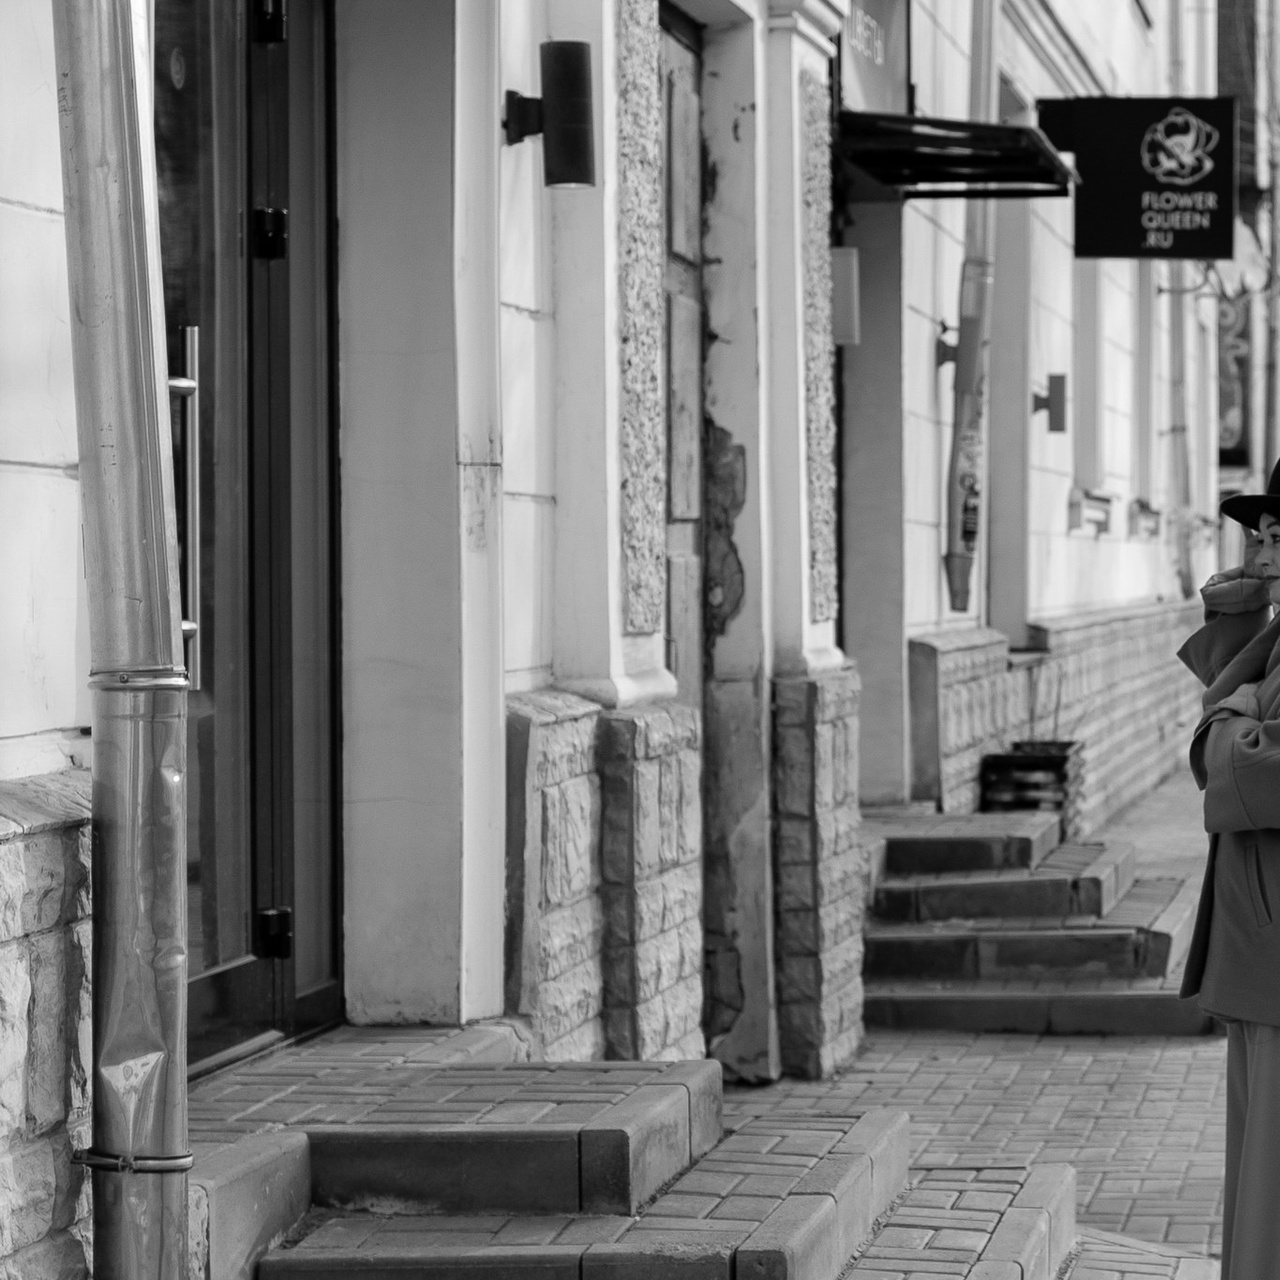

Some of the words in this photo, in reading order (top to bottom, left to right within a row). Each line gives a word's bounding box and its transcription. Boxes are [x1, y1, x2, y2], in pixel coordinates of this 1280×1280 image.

[1141, 191, 1218, 210] FLOWER
[1141, 210, 1210, 230] QUEEN
[1142, 230, 1173, 249] .RU
